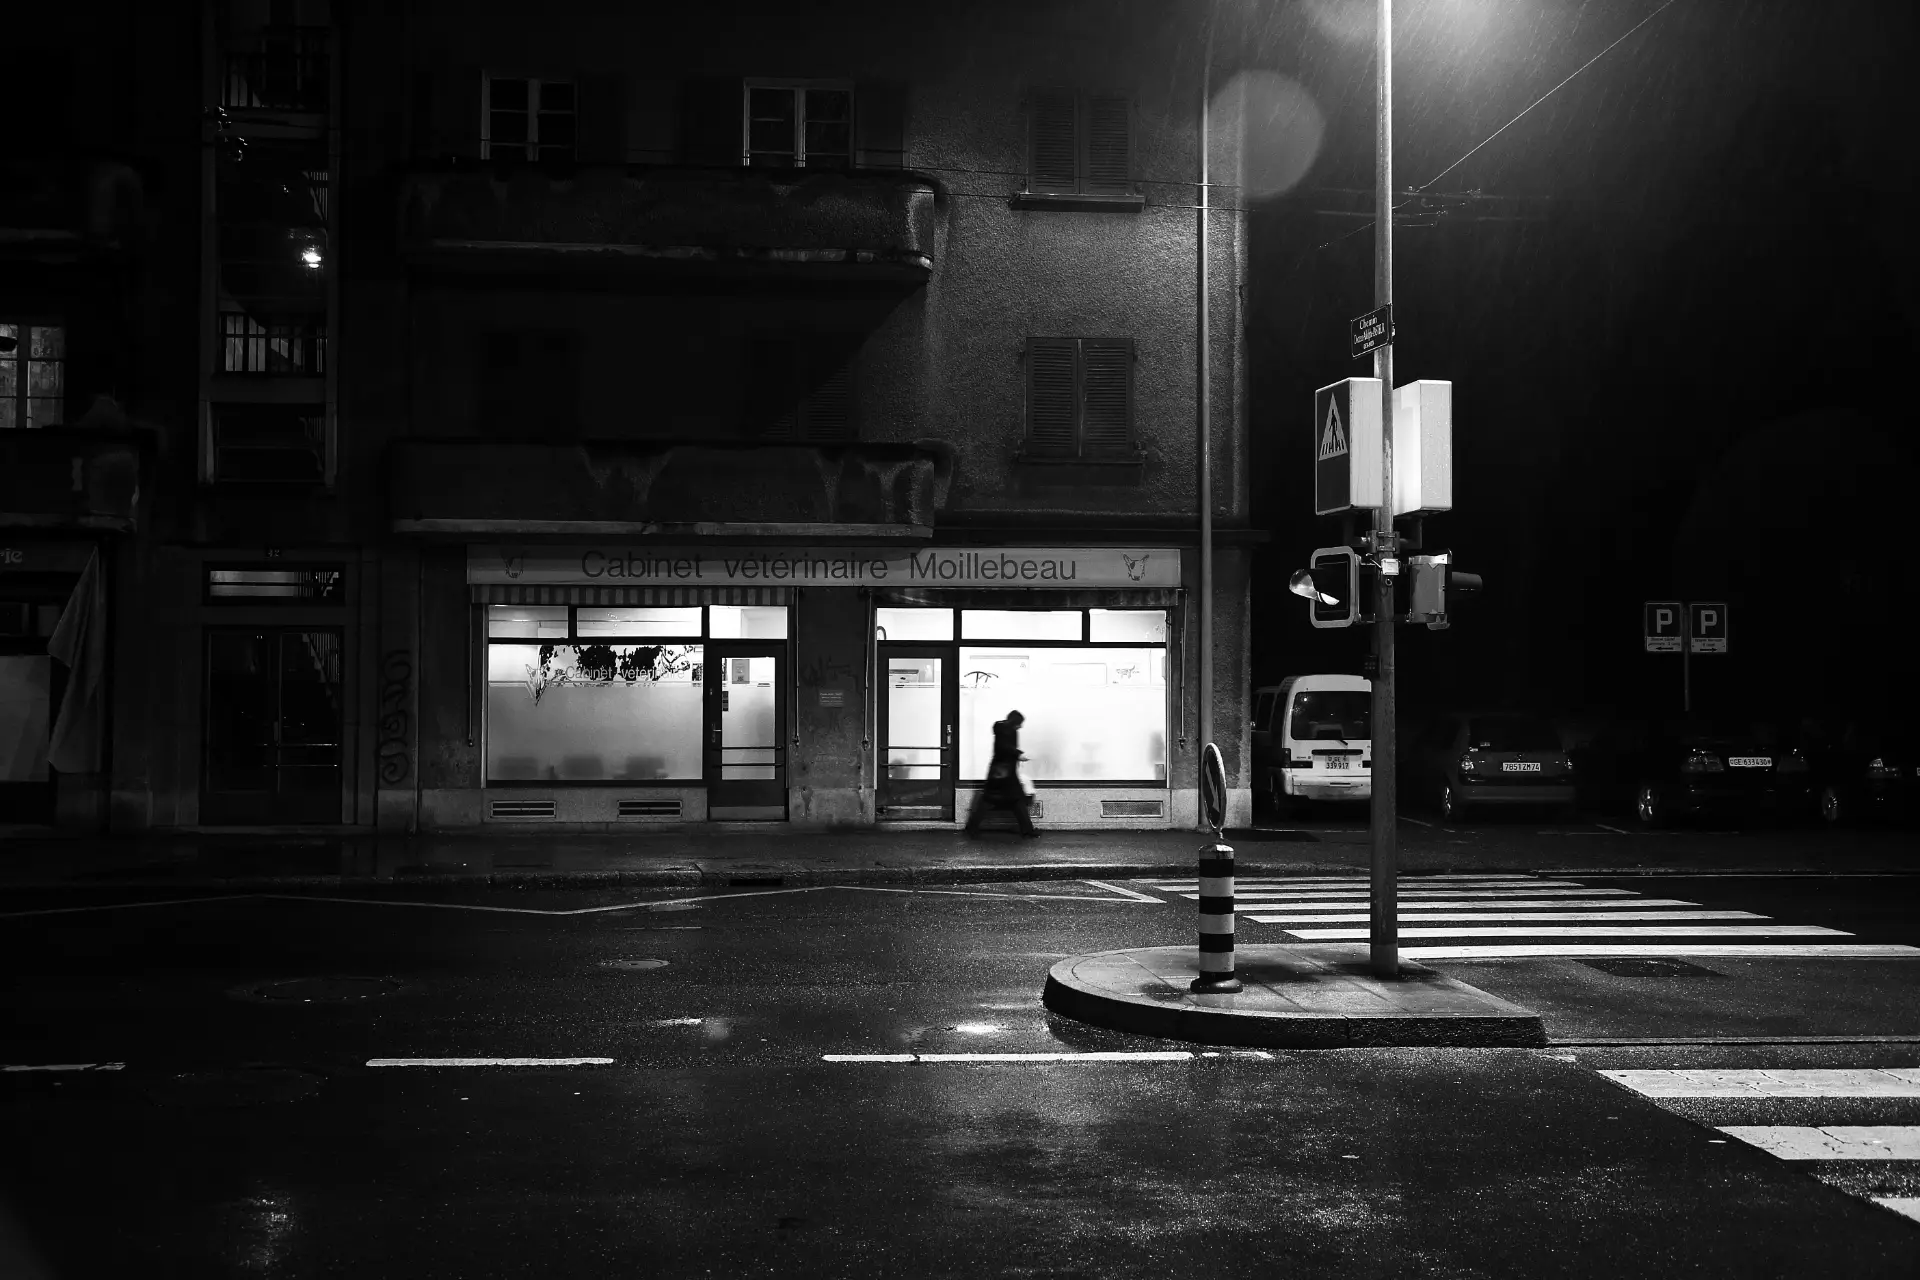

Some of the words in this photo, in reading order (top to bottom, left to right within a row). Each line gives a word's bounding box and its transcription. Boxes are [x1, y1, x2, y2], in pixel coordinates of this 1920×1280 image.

[581, 550, 703, 578] Cabinet
[724, 552, 888, 579] vétérinaire
[910, 552, 1077, 580] Moillebeau
[1656, 608, 1673, 634] P
[1701, 609, 1718, 635] P
[565, 665, 613, 680] Cabinet
